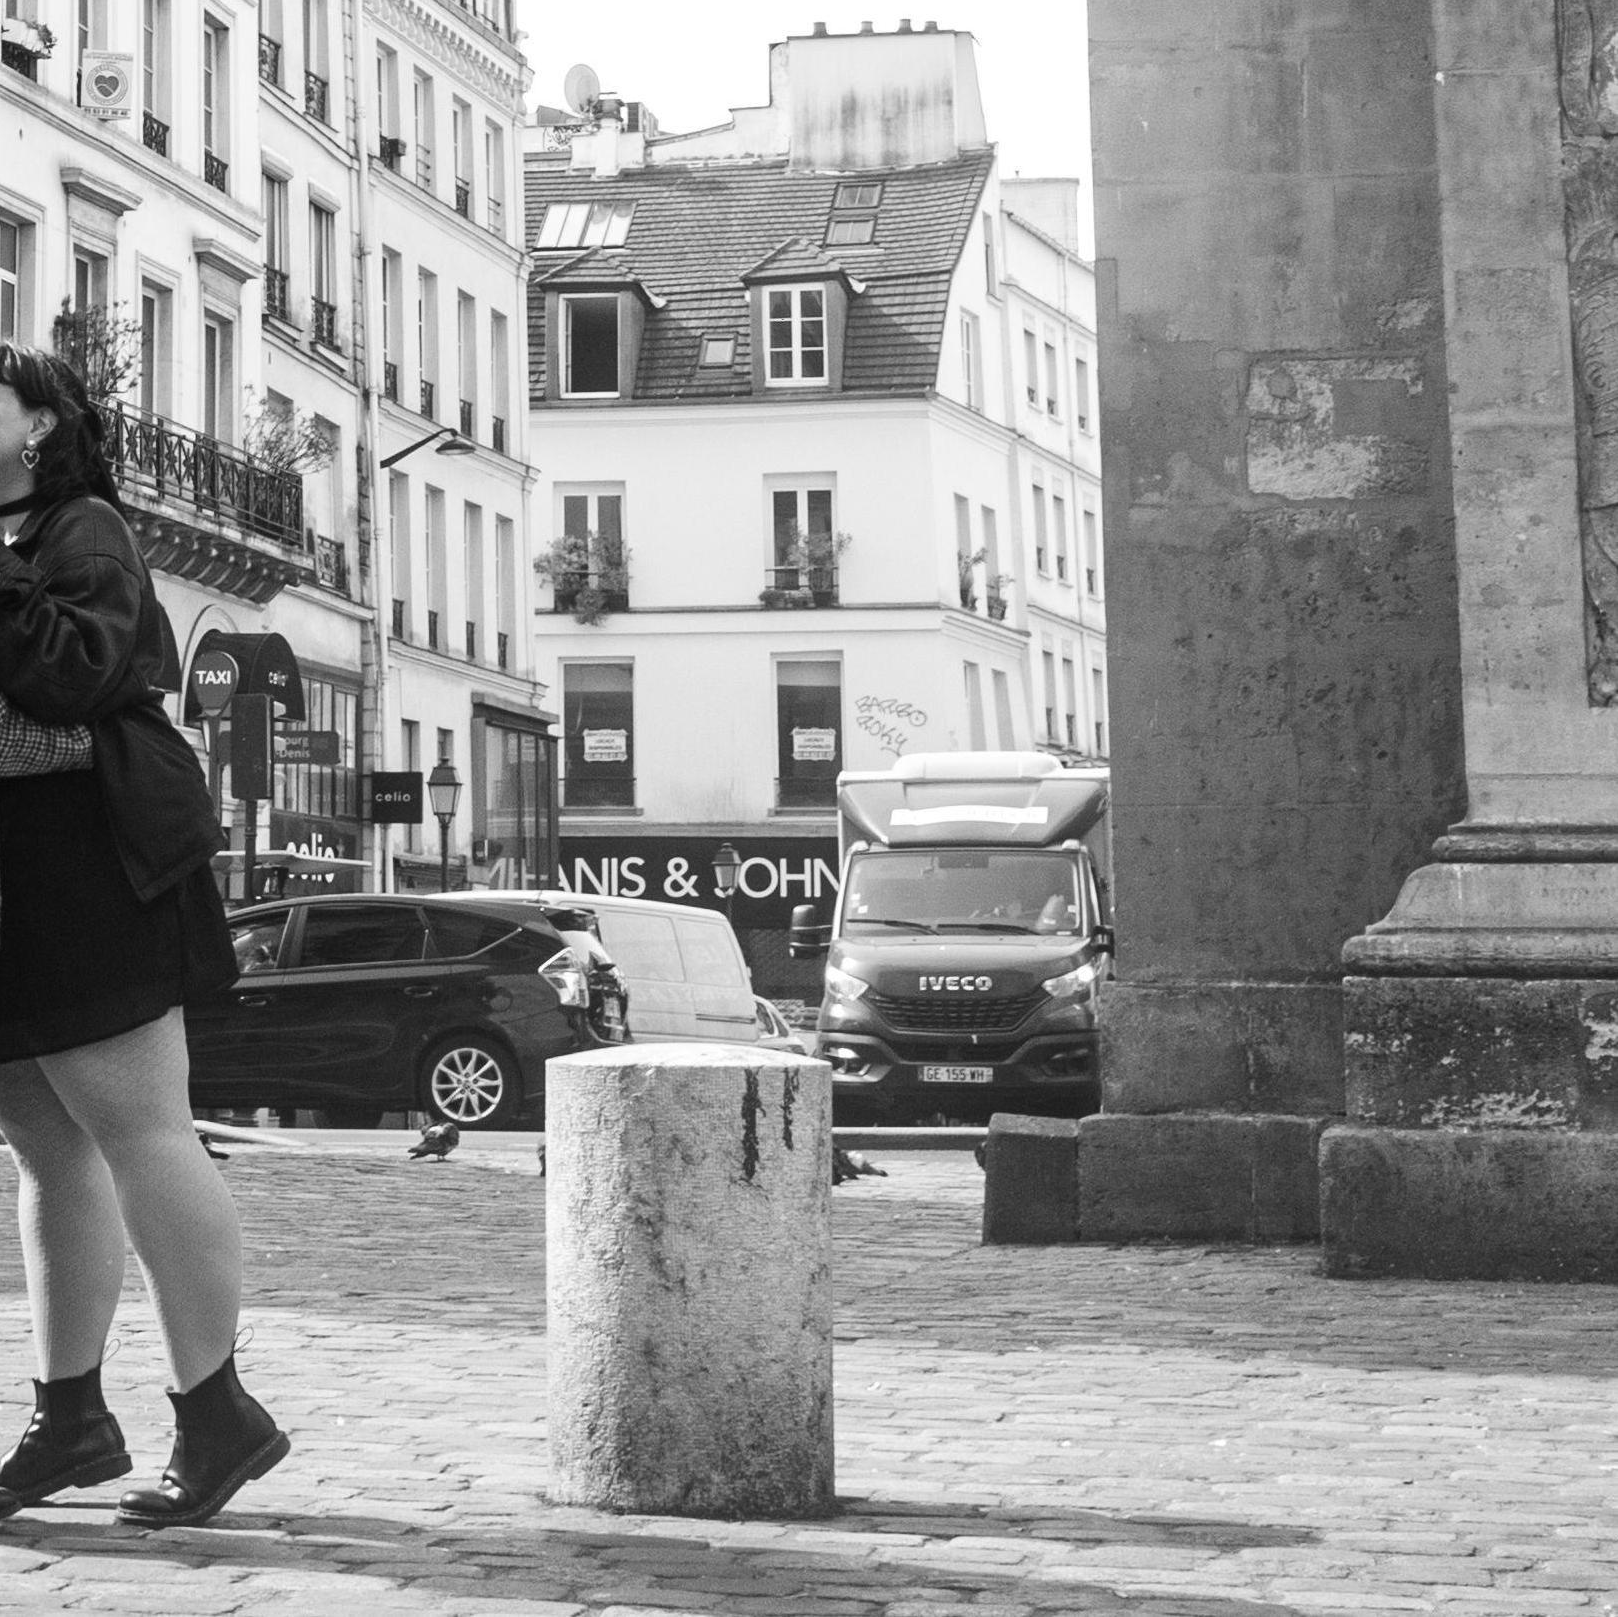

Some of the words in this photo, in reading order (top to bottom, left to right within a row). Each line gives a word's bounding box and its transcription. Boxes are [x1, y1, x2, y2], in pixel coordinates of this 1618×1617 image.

[195, 670, 232, 685] TAXI
[374, 791, 412, 803] celio
[662, 856, 701, 899] &
[713, 856, 841, 899] OHN
[919, 975, 993, 992] IVECO
